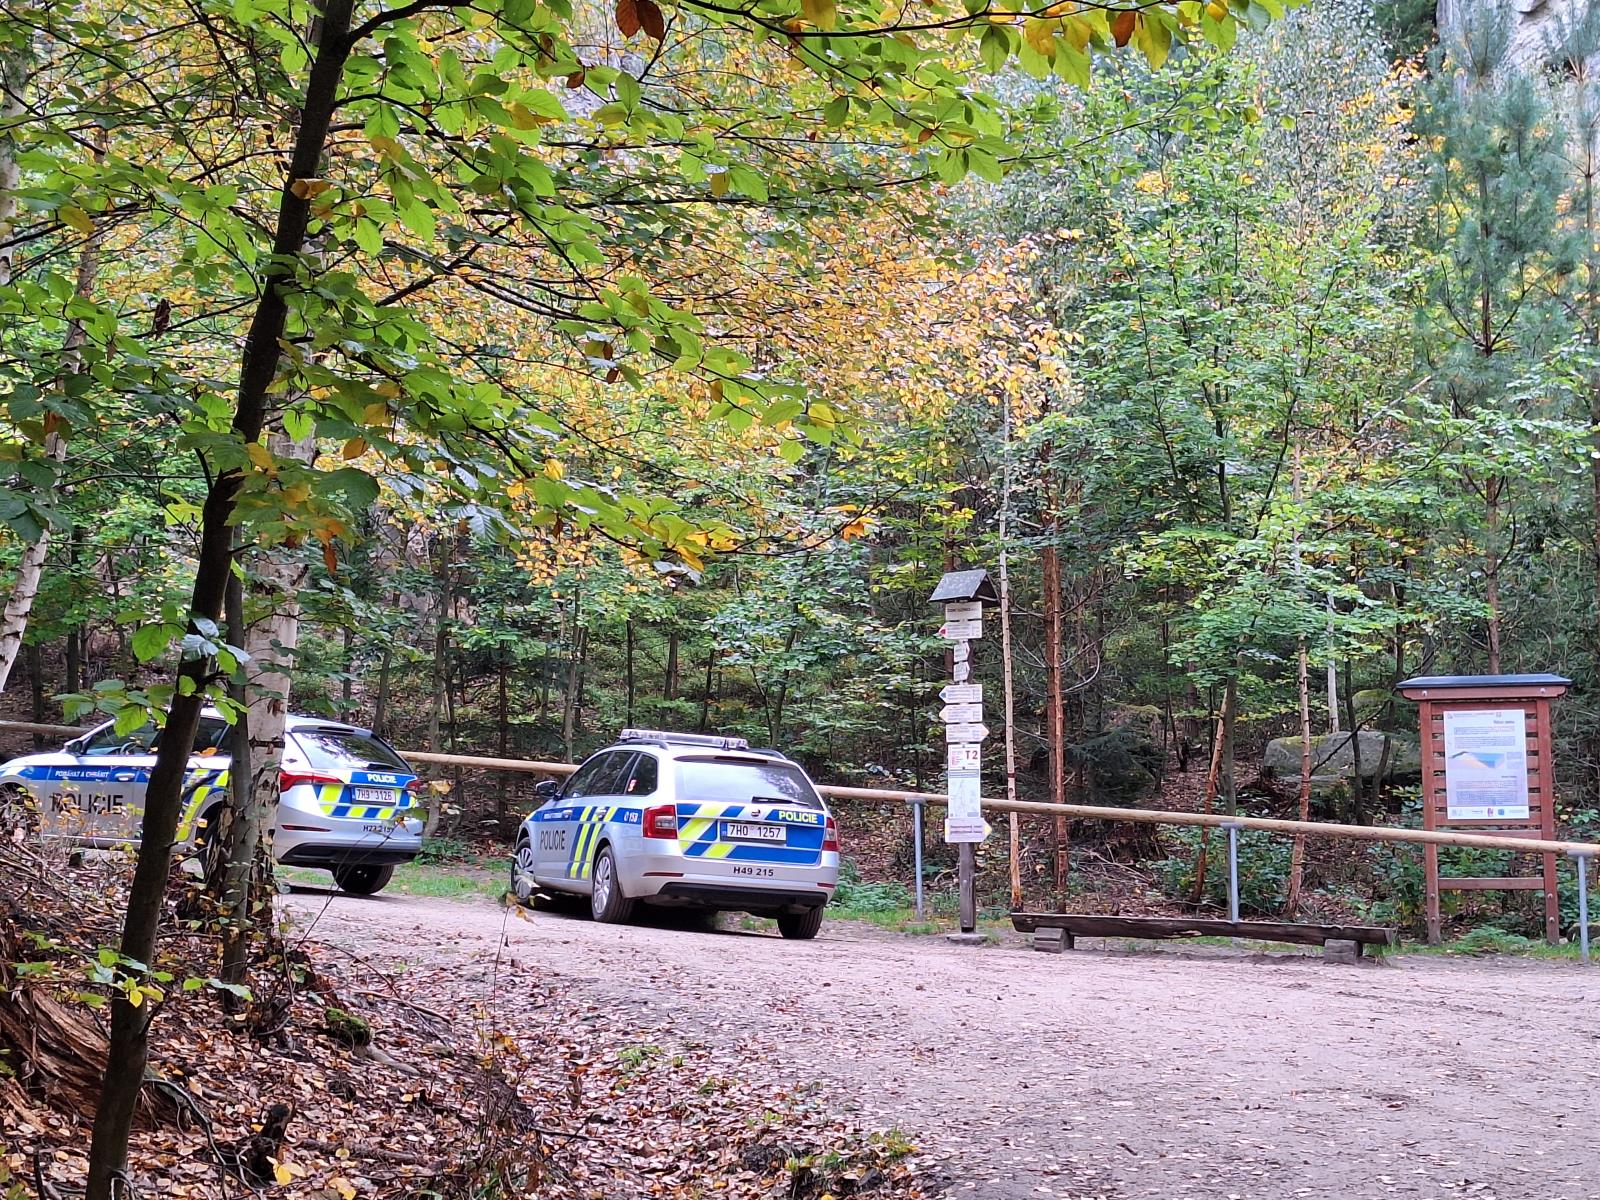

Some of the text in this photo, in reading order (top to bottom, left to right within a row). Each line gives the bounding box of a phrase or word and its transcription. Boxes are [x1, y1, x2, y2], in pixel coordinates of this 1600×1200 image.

[367, 773, 397, 783] POLICIE
[51, 792, 124, 815] POLICIE
[778, 811, 818, 823] POLICIE
[729, 824, 781, 838] 7H0 1257
[540, 830, 566, 851] POLICIE
[733, 866, 774, 877] H49 215
